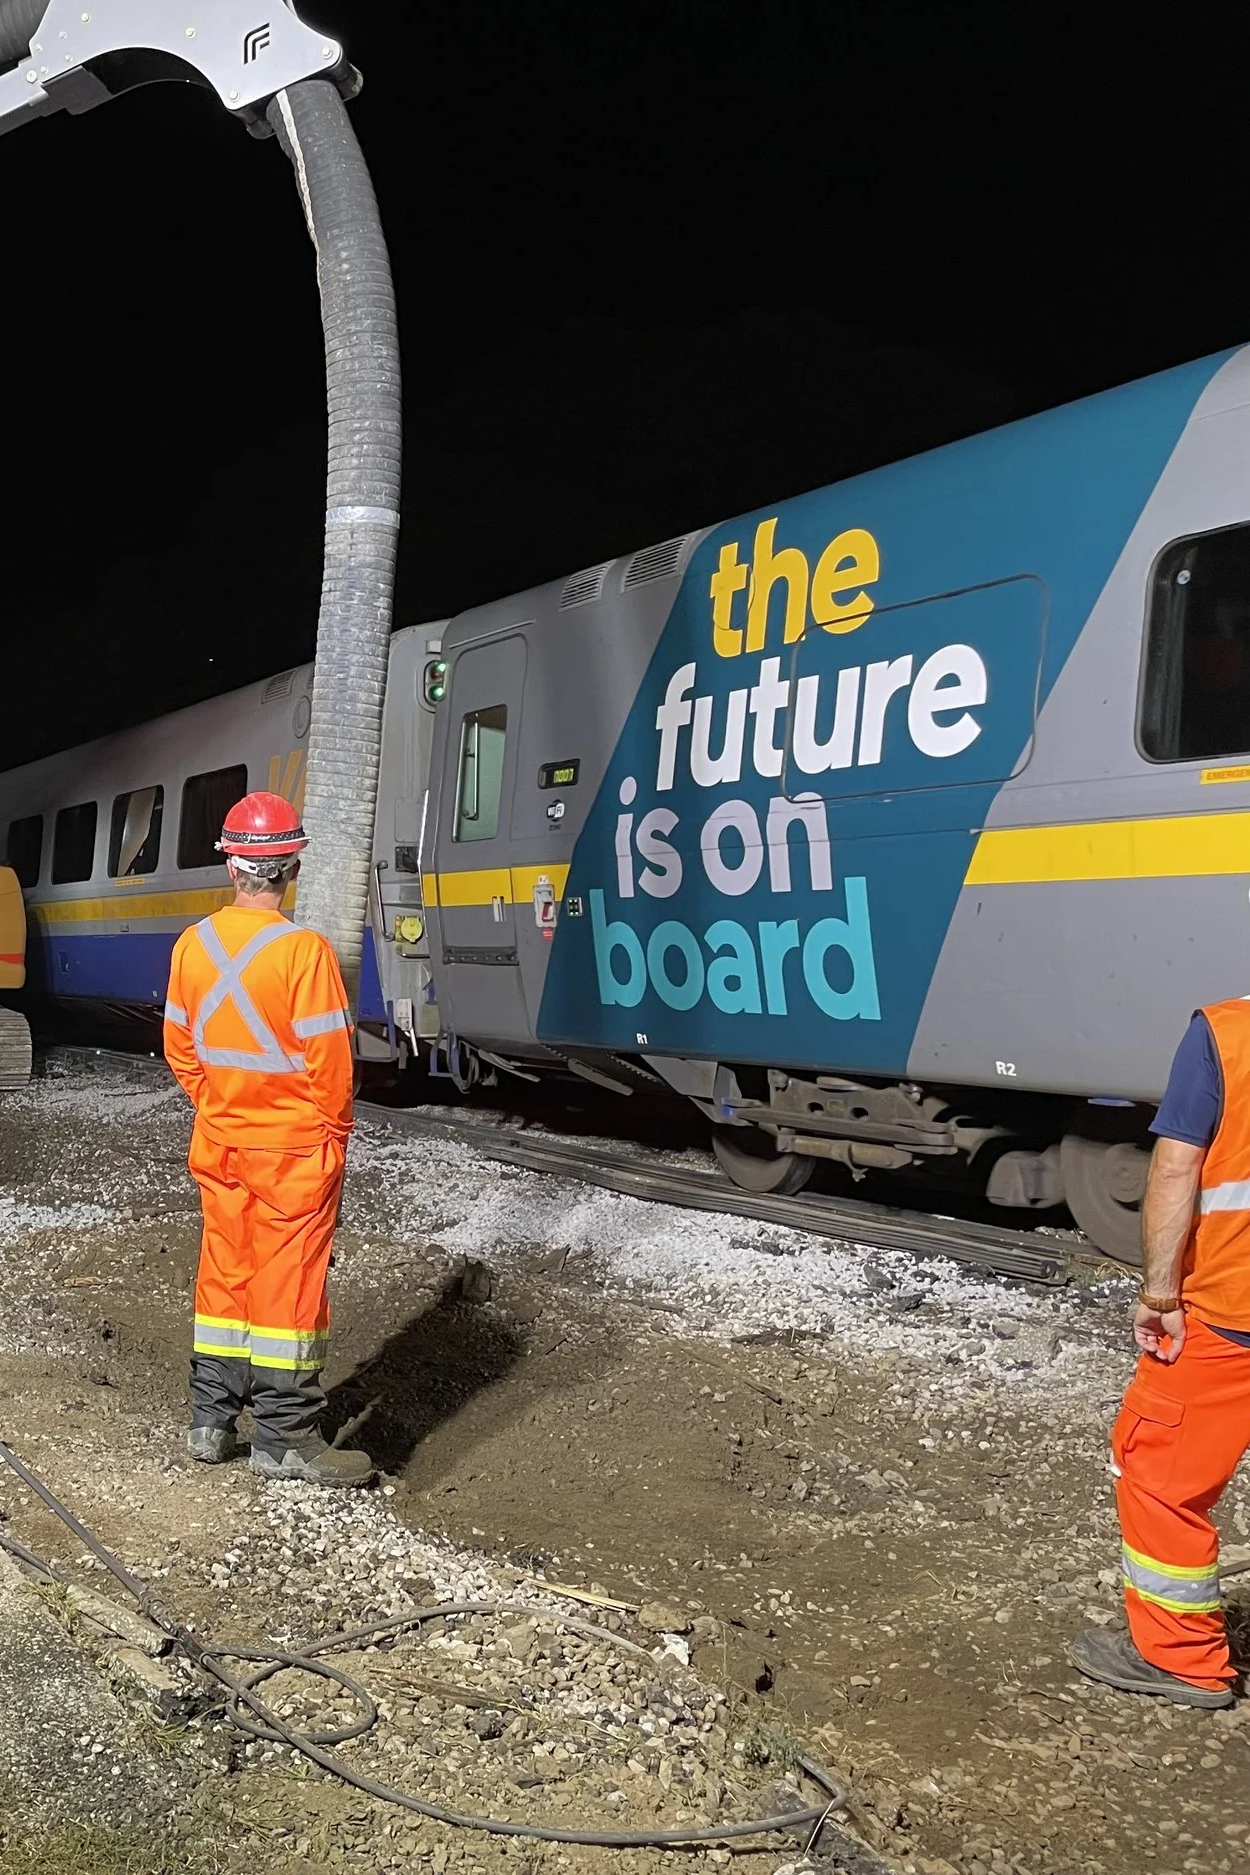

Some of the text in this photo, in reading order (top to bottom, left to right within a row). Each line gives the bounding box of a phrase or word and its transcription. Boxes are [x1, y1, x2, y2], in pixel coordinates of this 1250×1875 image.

[710, 517, 880, 658] the
[655, 643, 988, 792] future
[615, 776, 833, 899] is on
[589, 876, 882, 1021] board
[636, 1032, 649, 1045] R1
[995, 1060, 1018, 1077] R2
